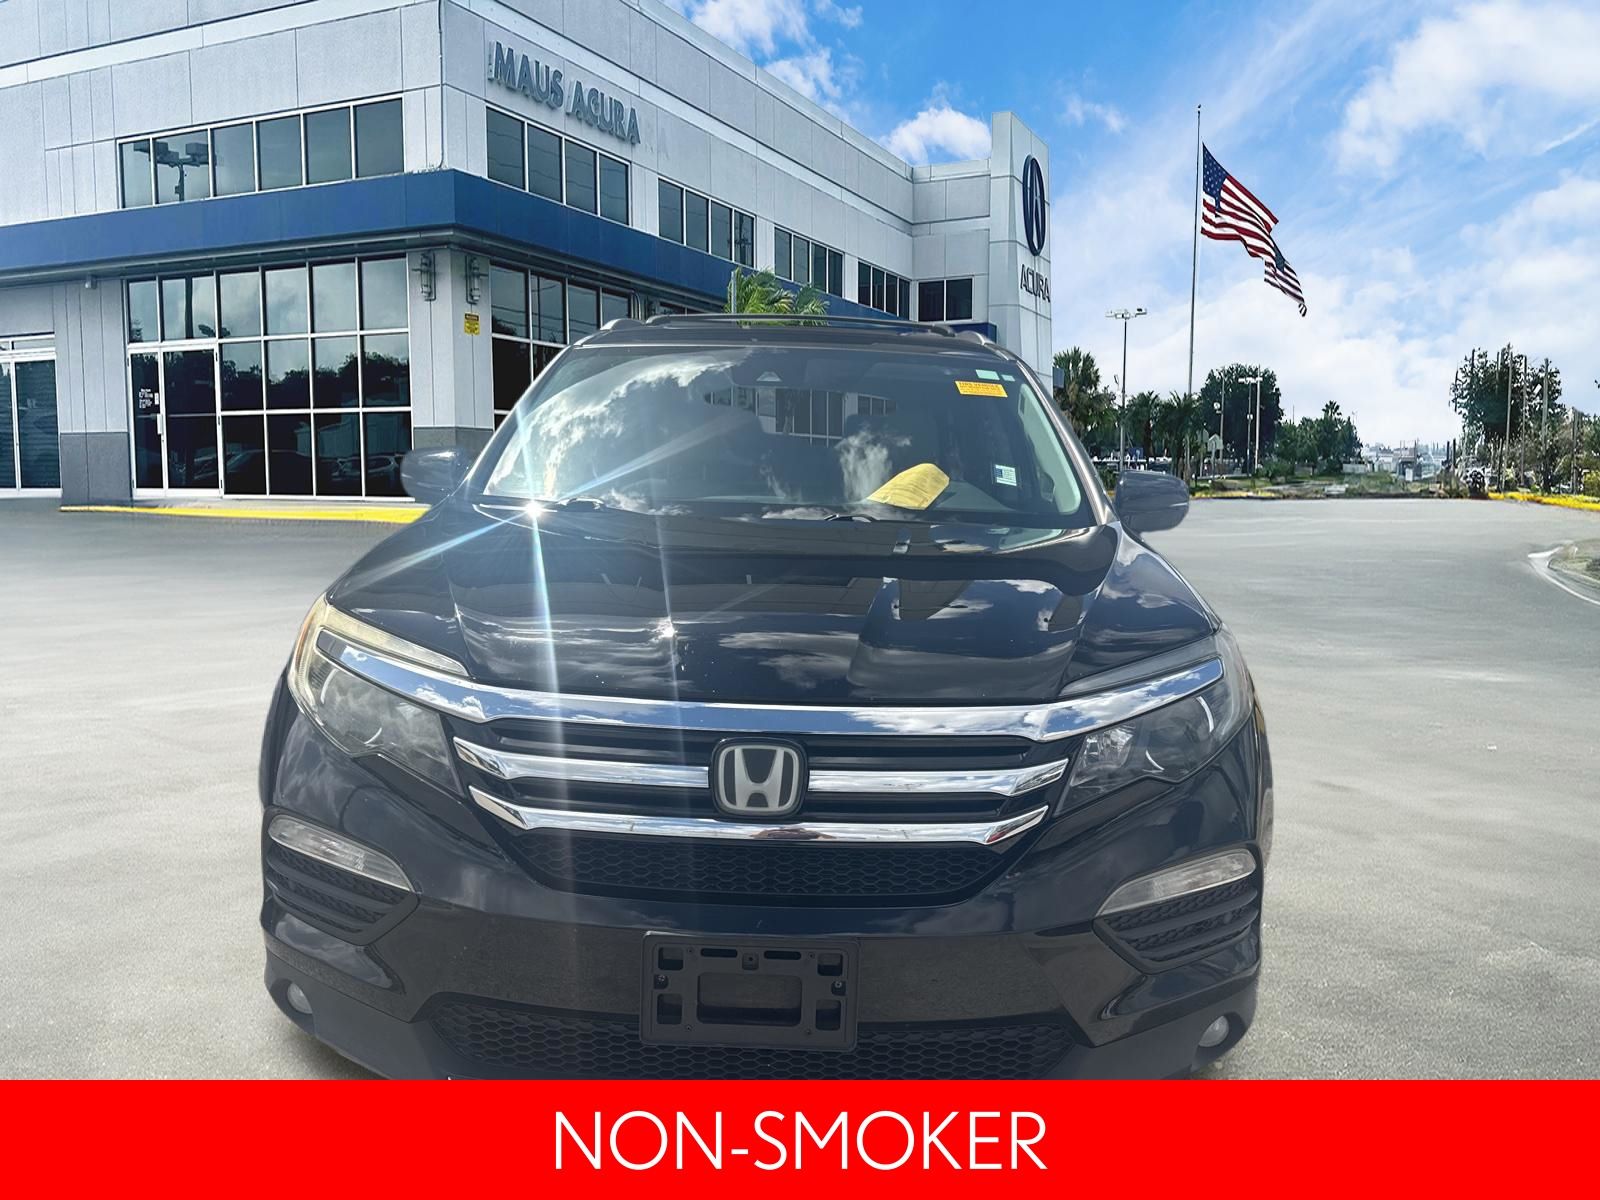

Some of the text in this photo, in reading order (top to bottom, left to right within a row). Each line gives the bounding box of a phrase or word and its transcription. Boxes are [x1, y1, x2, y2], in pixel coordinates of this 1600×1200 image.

[488, 41, 641, 145] MAUS ACURA
[1020, 263, 1050, 303] ACURA
